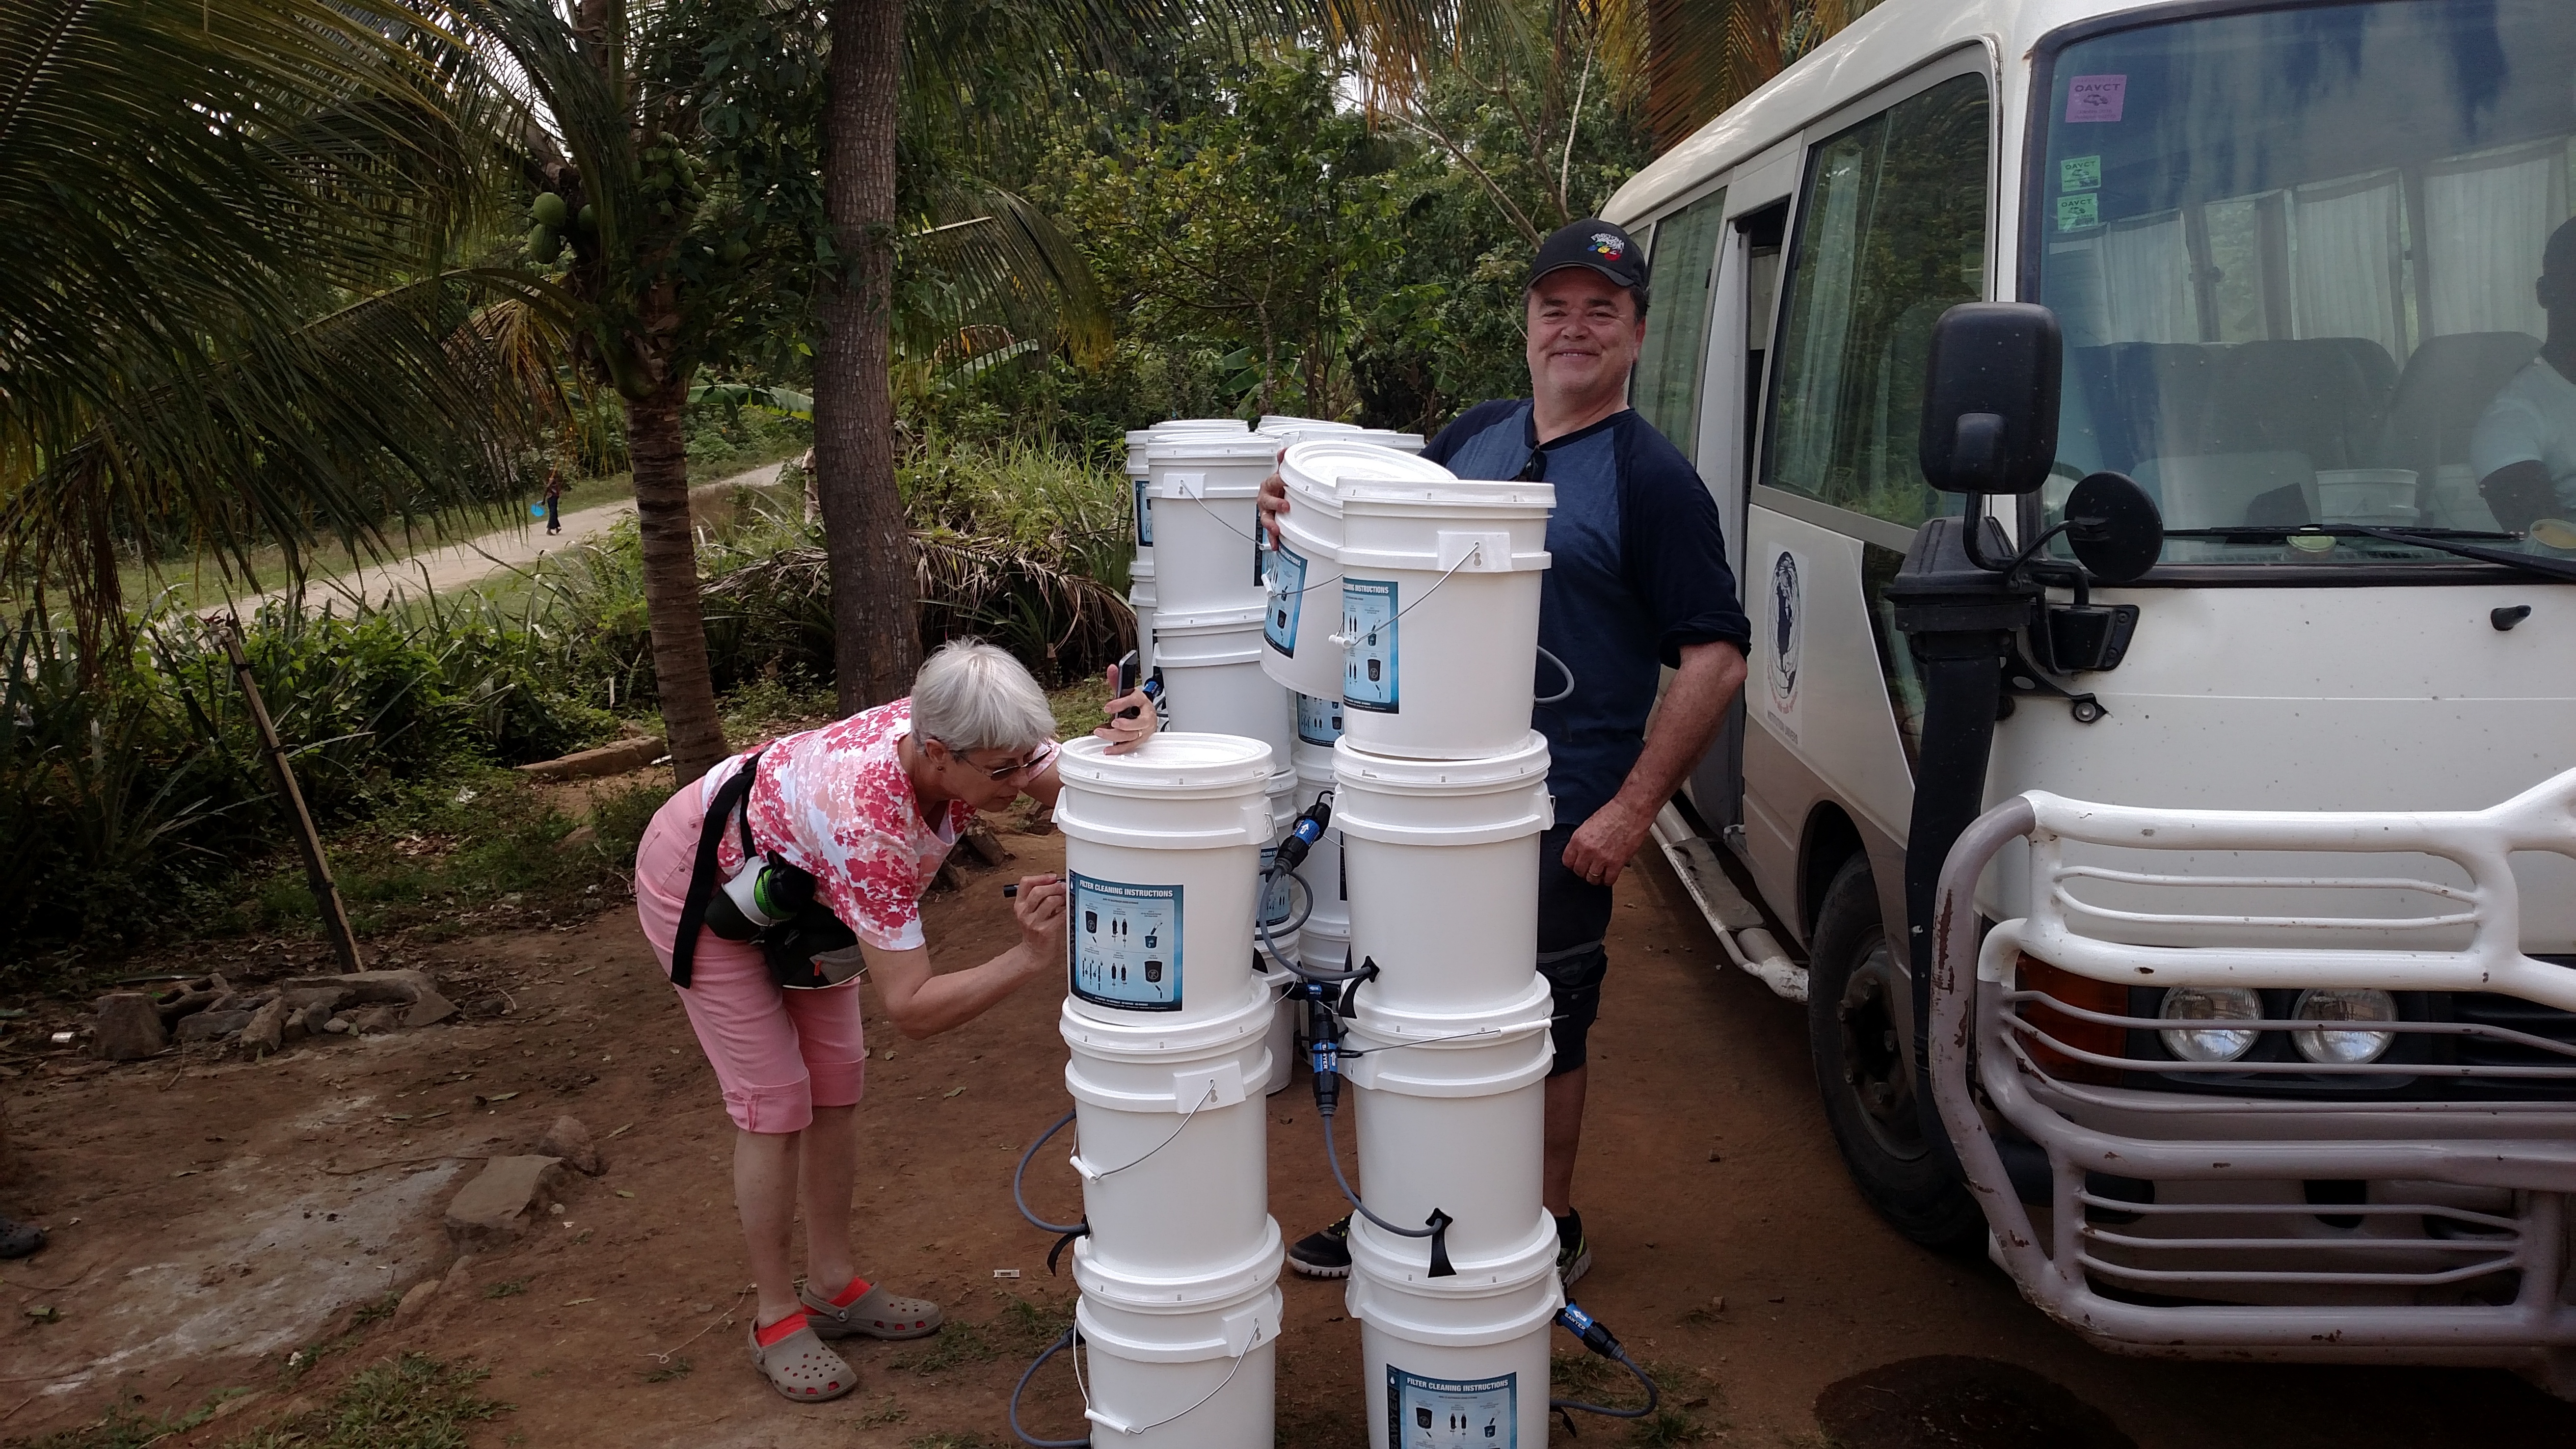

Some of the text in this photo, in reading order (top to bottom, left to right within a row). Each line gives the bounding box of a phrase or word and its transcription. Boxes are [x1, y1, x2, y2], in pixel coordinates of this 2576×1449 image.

[2074, 83, 2120, 92] OAVCT
[2065, 161, 2095, 170] OAVCT
[2061, 198, 2092, 207] OAVCT
[1355, 585, 1389, 594] INSTRUCTIONS
[1079, 880, 1173, 897] FILTER CLEANING INSTRUCTIONS
[1564, 1313, 1586, 1330] SAWYER
[1407, 1377, 1508, 1392] FILTER CLEANING INSTRUCTIONS
